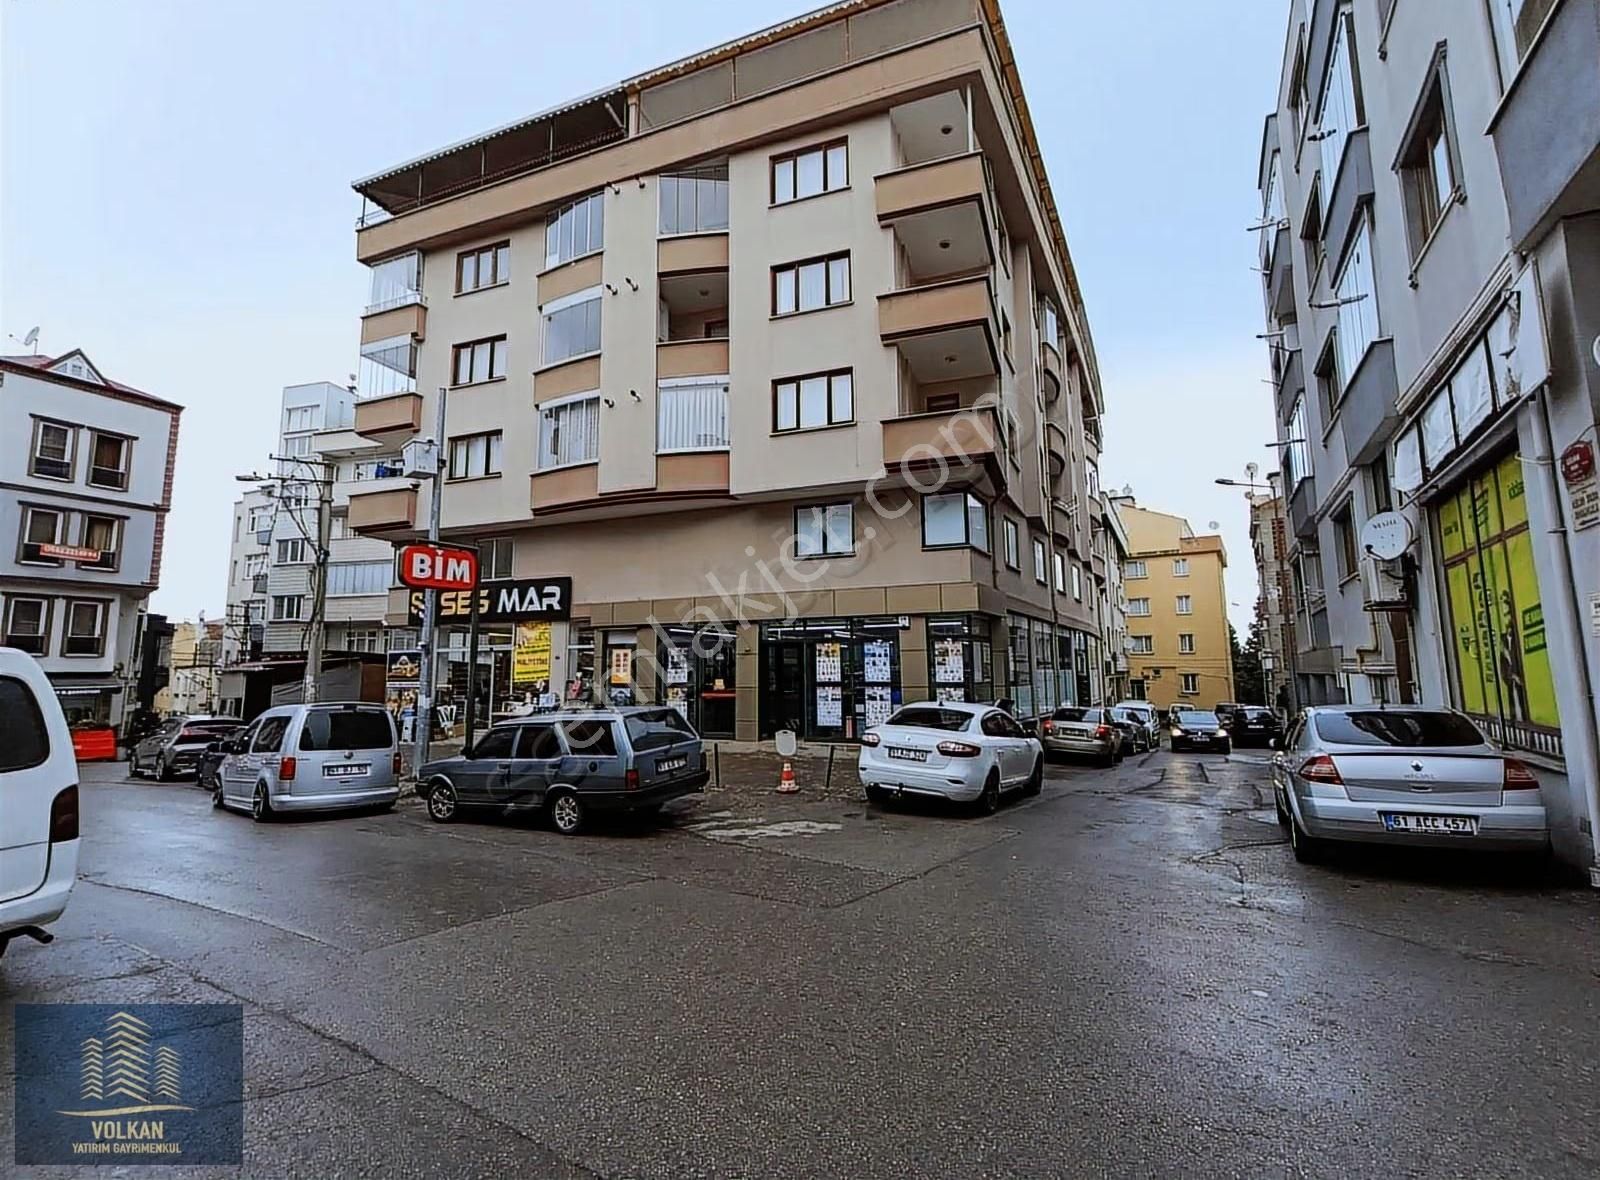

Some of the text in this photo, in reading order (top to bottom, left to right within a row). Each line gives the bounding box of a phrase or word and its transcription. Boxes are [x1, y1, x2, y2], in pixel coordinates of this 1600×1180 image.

[412, 549, 471, 584] BİM
[497, 585, 562, 613] MAR
[1393, 815, 1468, 831] 61 ACC 457
